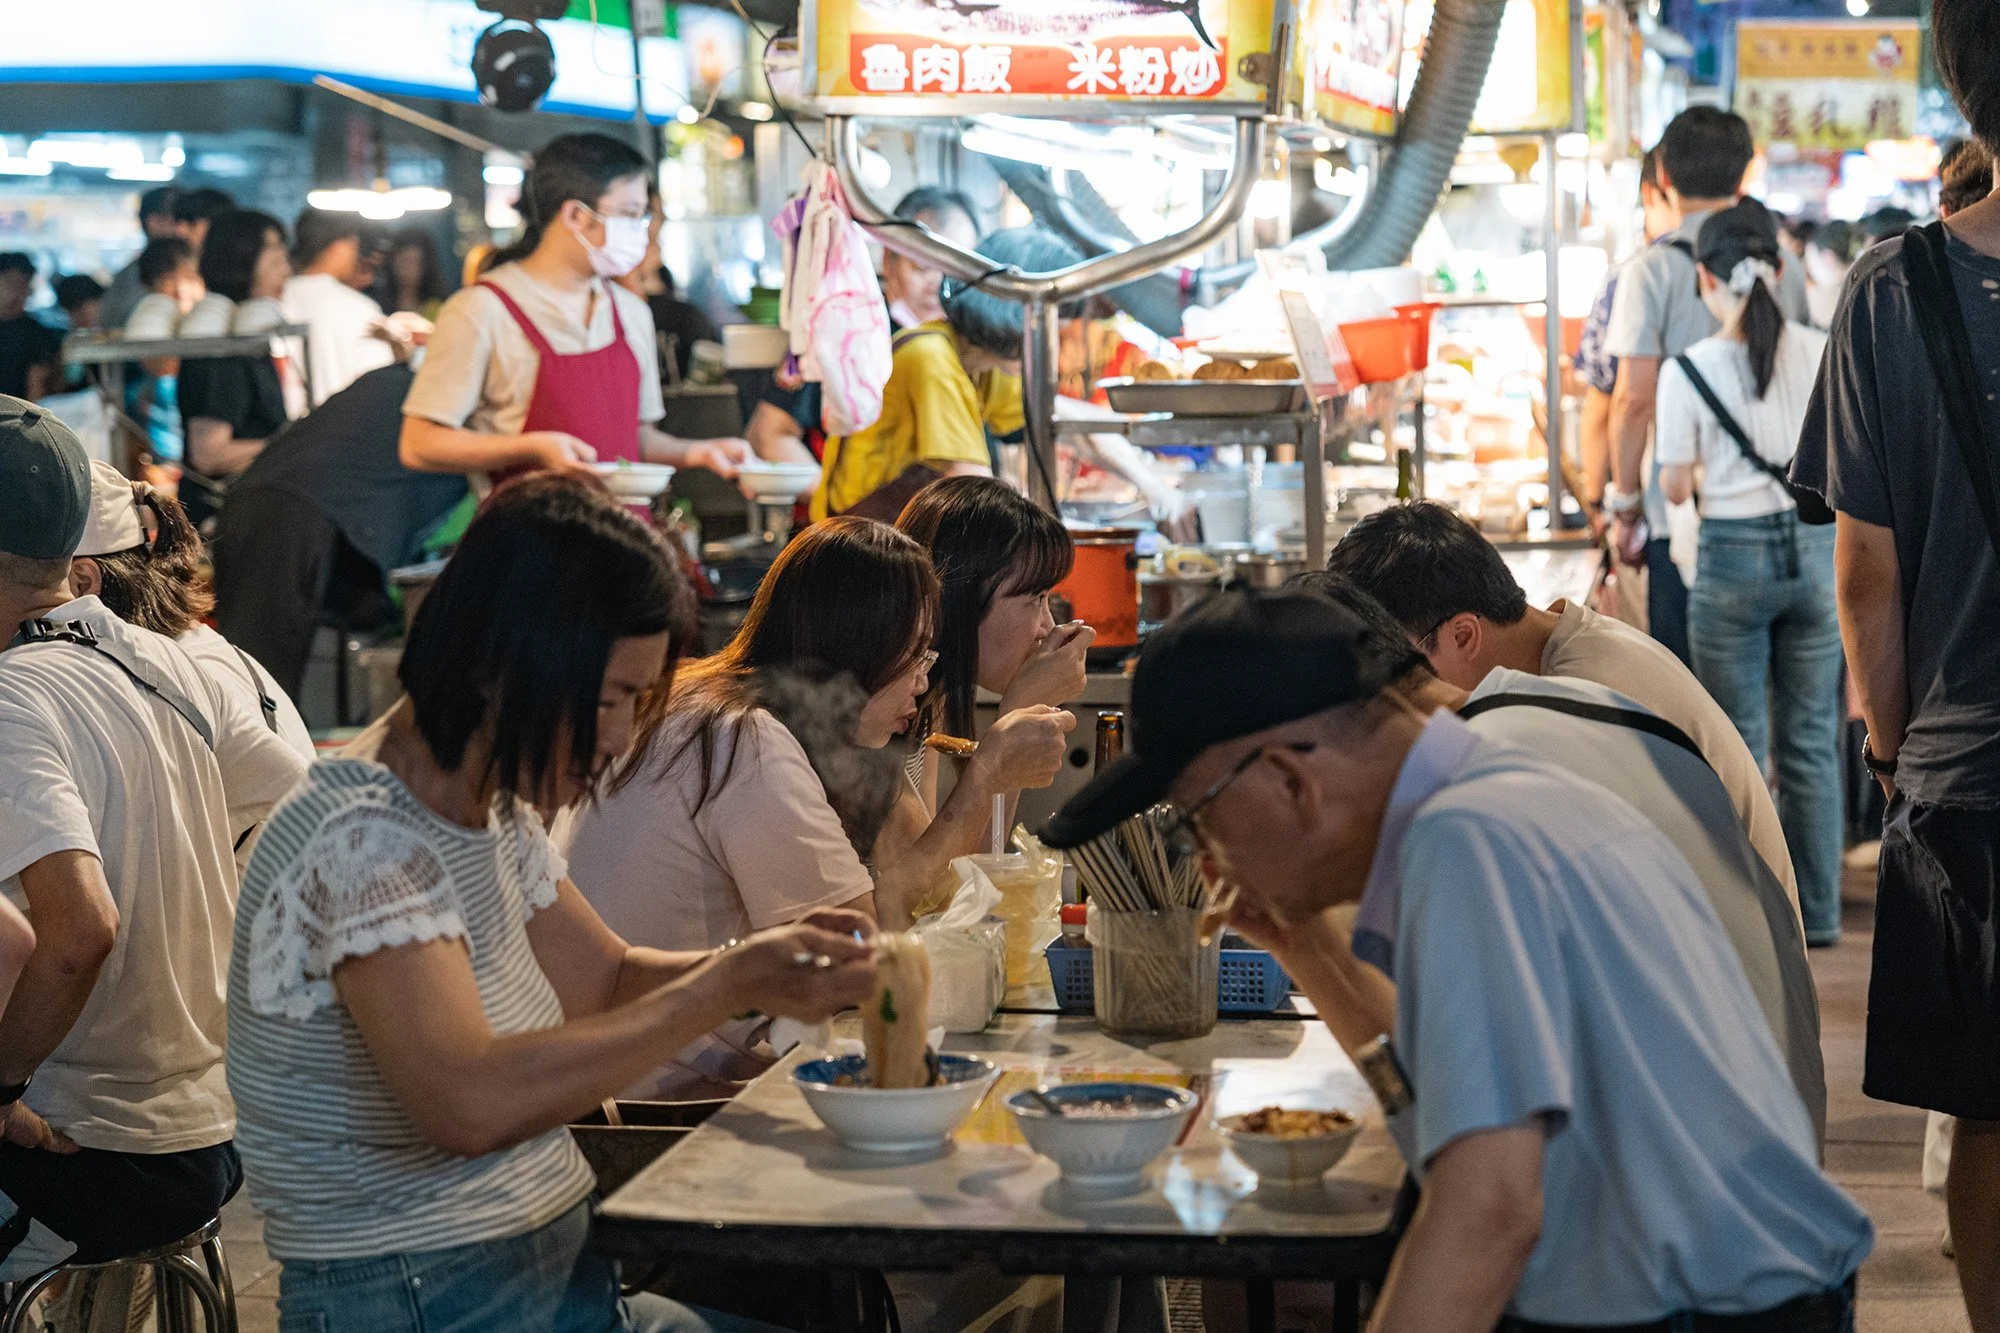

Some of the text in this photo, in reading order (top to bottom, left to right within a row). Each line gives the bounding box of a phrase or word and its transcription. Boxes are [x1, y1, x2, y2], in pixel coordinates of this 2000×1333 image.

[861, 43, 1221, 95] 魯肉飯 米粉炒
